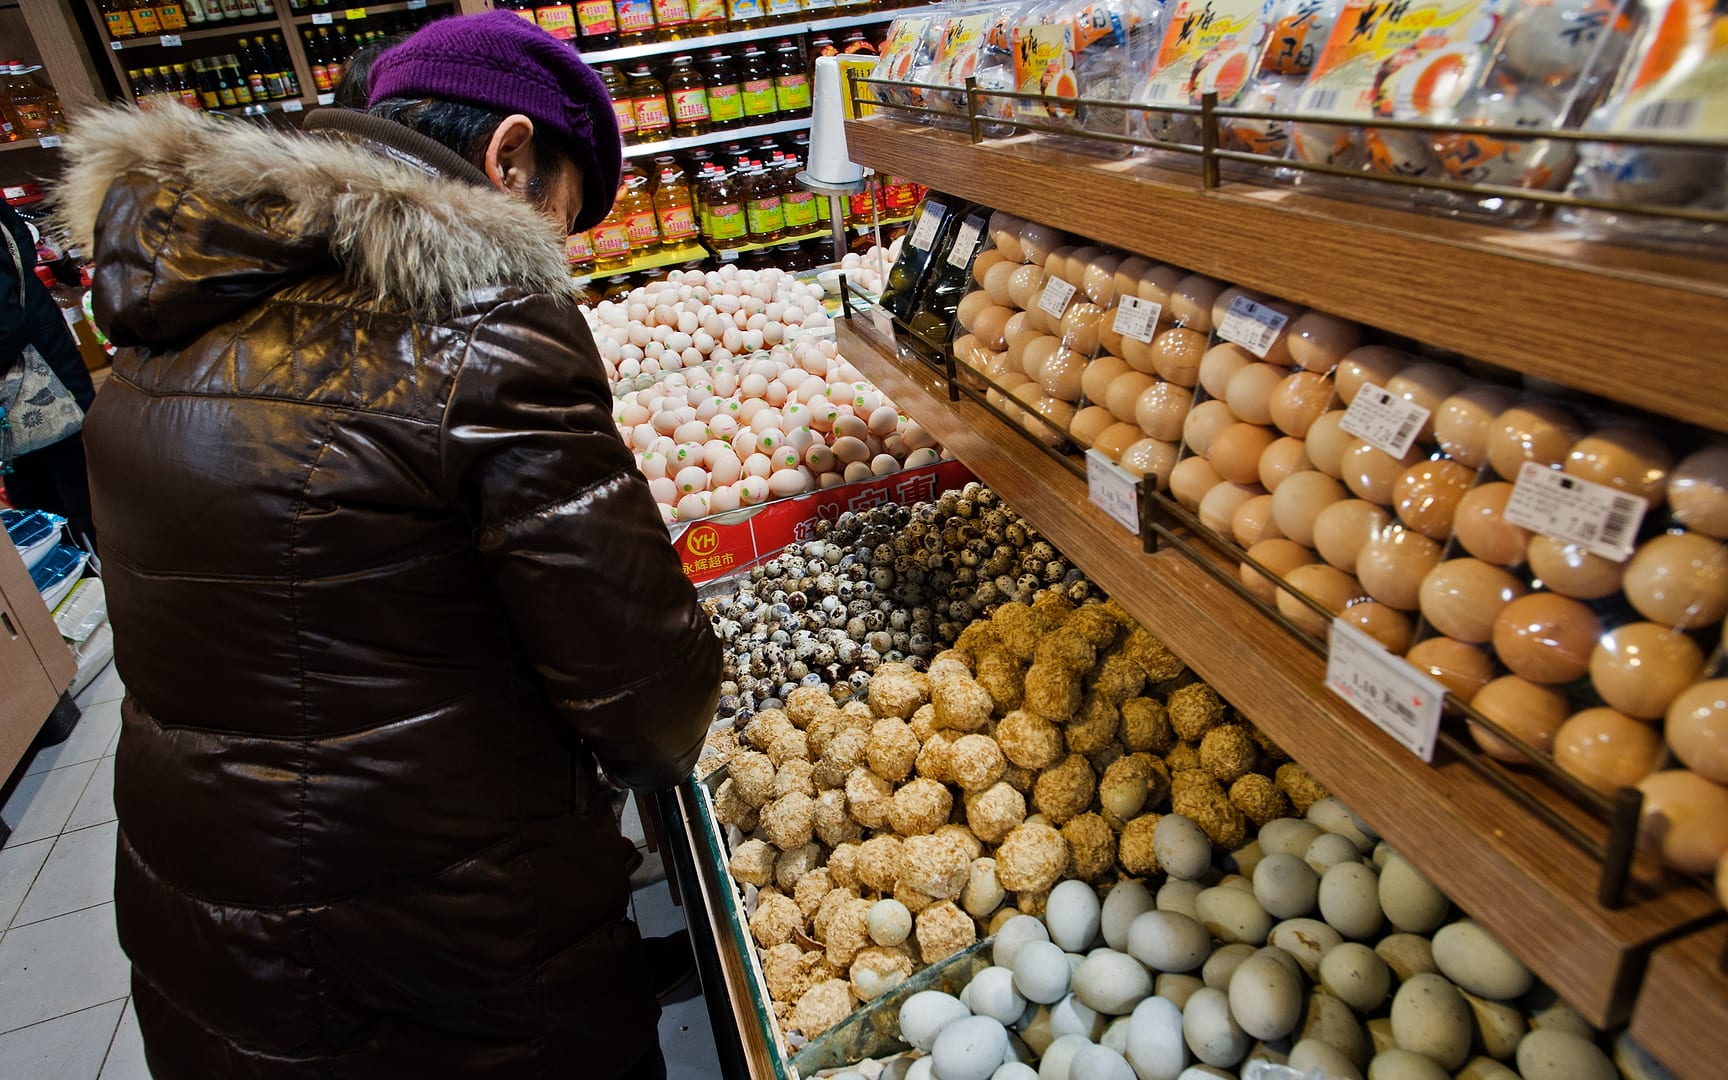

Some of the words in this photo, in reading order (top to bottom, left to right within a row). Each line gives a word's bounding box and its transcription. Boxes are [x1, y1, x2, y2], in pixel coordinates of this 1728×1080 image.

[691, 530, 717, 552] YH
[682, 552, 735, 576] 永辉超市
